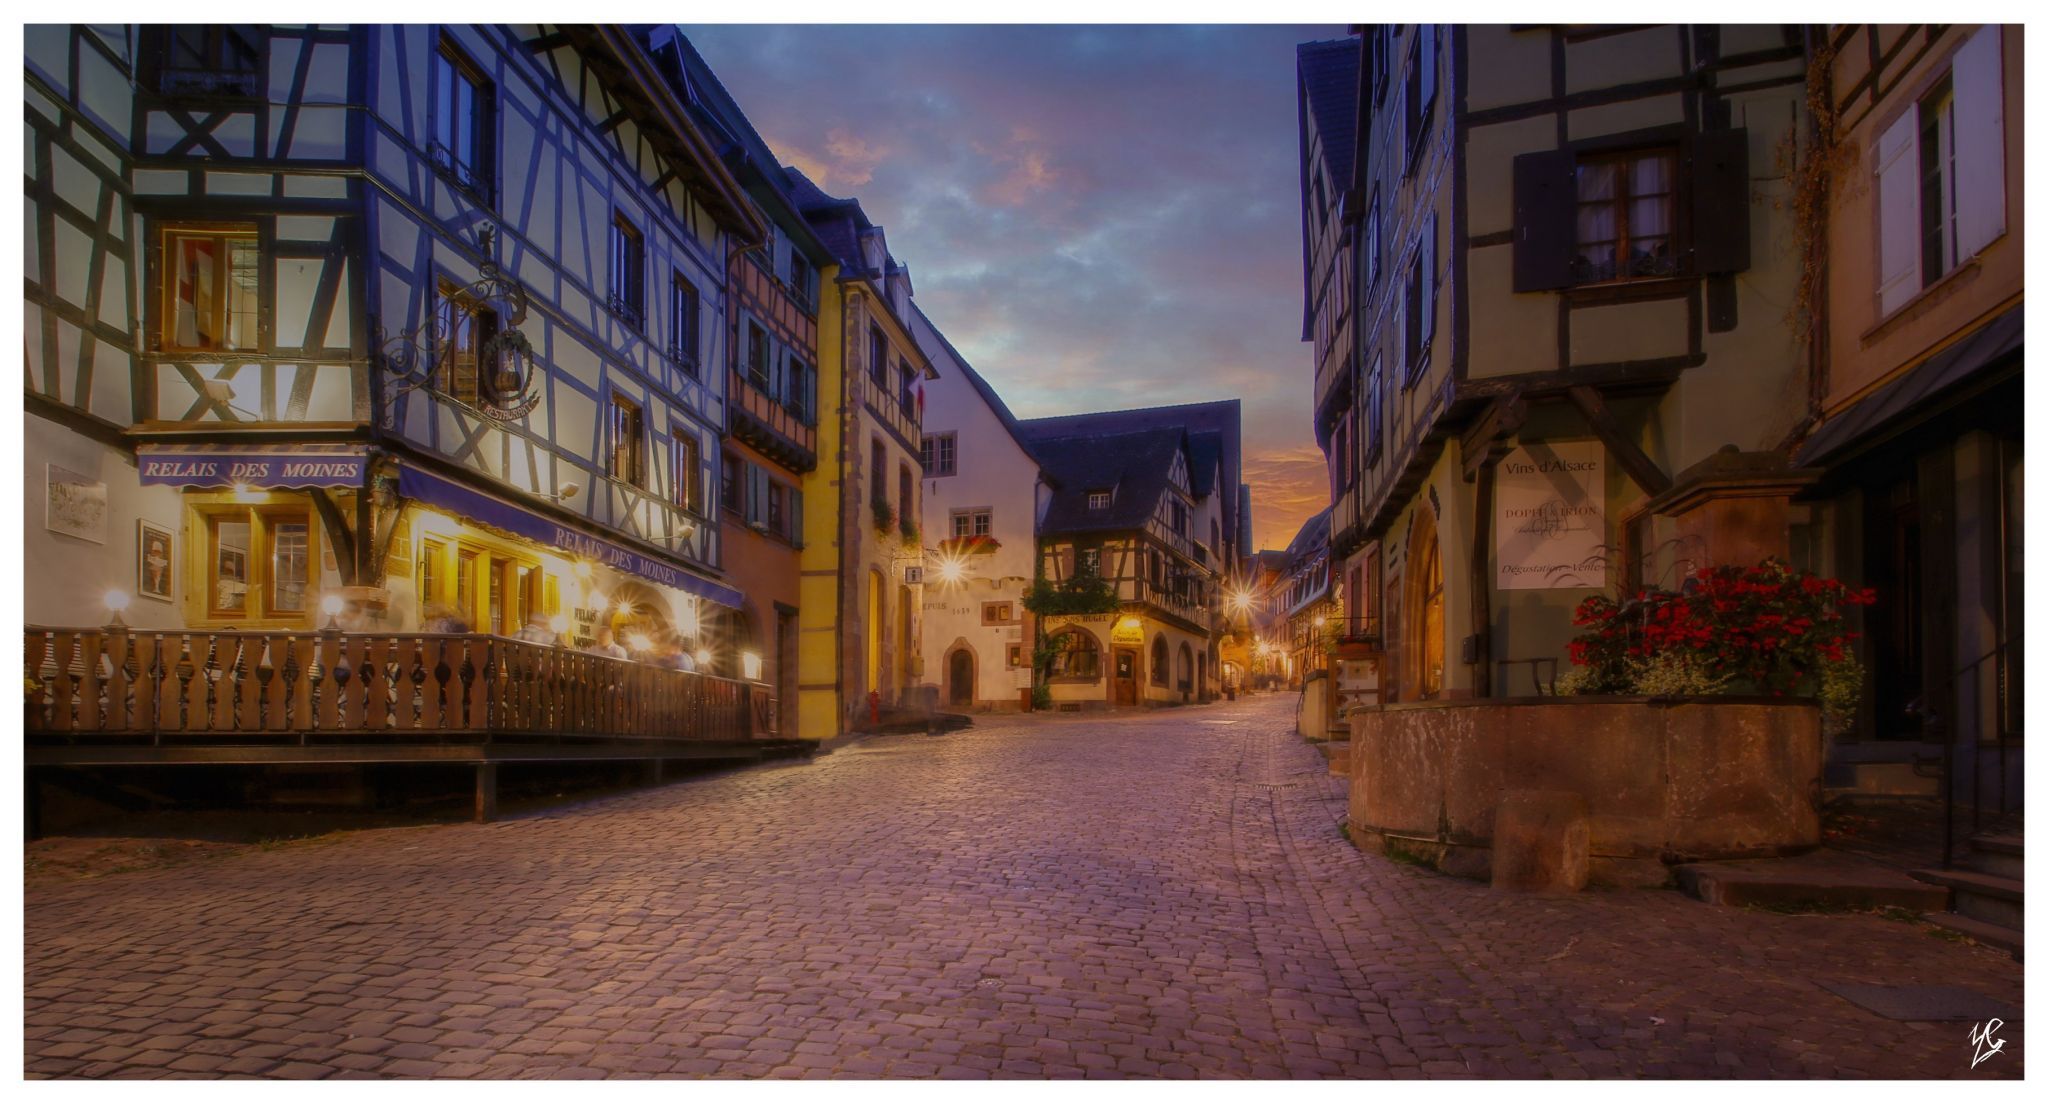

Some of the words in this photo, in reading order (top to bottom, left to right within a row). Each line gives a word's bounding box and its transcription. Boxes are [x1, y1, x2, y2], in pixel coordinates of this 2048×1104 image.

[484, 401, 532, 420] RESTAURANT
[144, 462, 218, 478] RELAIS
[230, 462, 270, 478] DES
[282, 462, 358, 478] MOINES
[1505, 463, 1535, 475] Vins
[1539, 460, 1597, 473] d'Alsace
[1561, 506, 1597, 517] IRION
[555, 527, 602, 560] RELAIS
[610, 548, 633, 570] DES
[639, 558, 677, 585] MOINES
[922, 602, 947, 611] EPUIS
